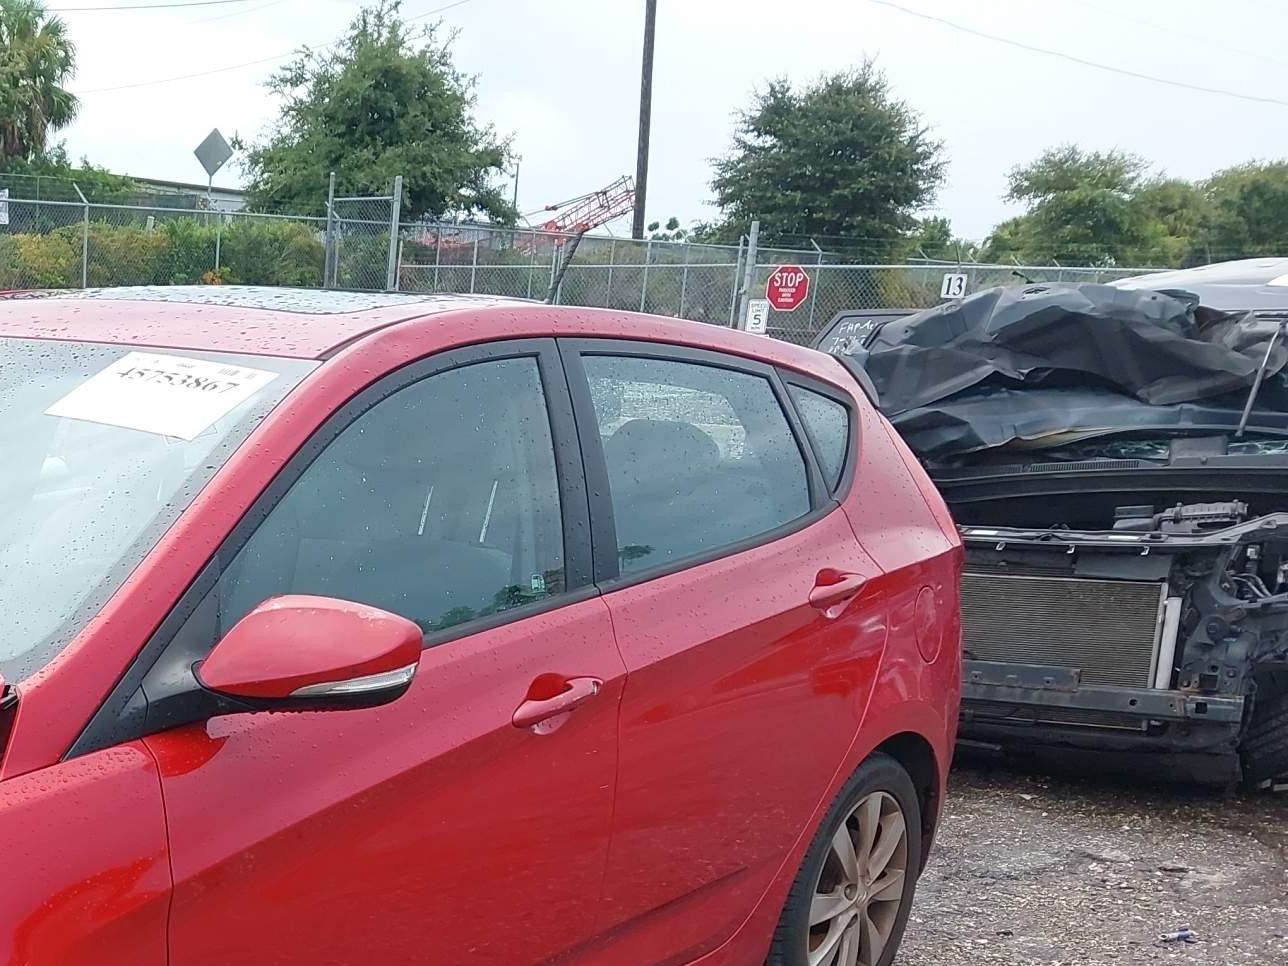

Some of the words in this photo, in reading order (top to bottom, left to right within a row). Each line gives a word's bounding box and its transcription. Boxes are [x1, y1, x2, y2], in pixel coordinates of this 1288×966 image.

[773, 272, 804, 287] STOP
[945, 277, 964, 296] 13
[753, 314, 761, 325] 5
[116, 367, 241, 394] 45753867
